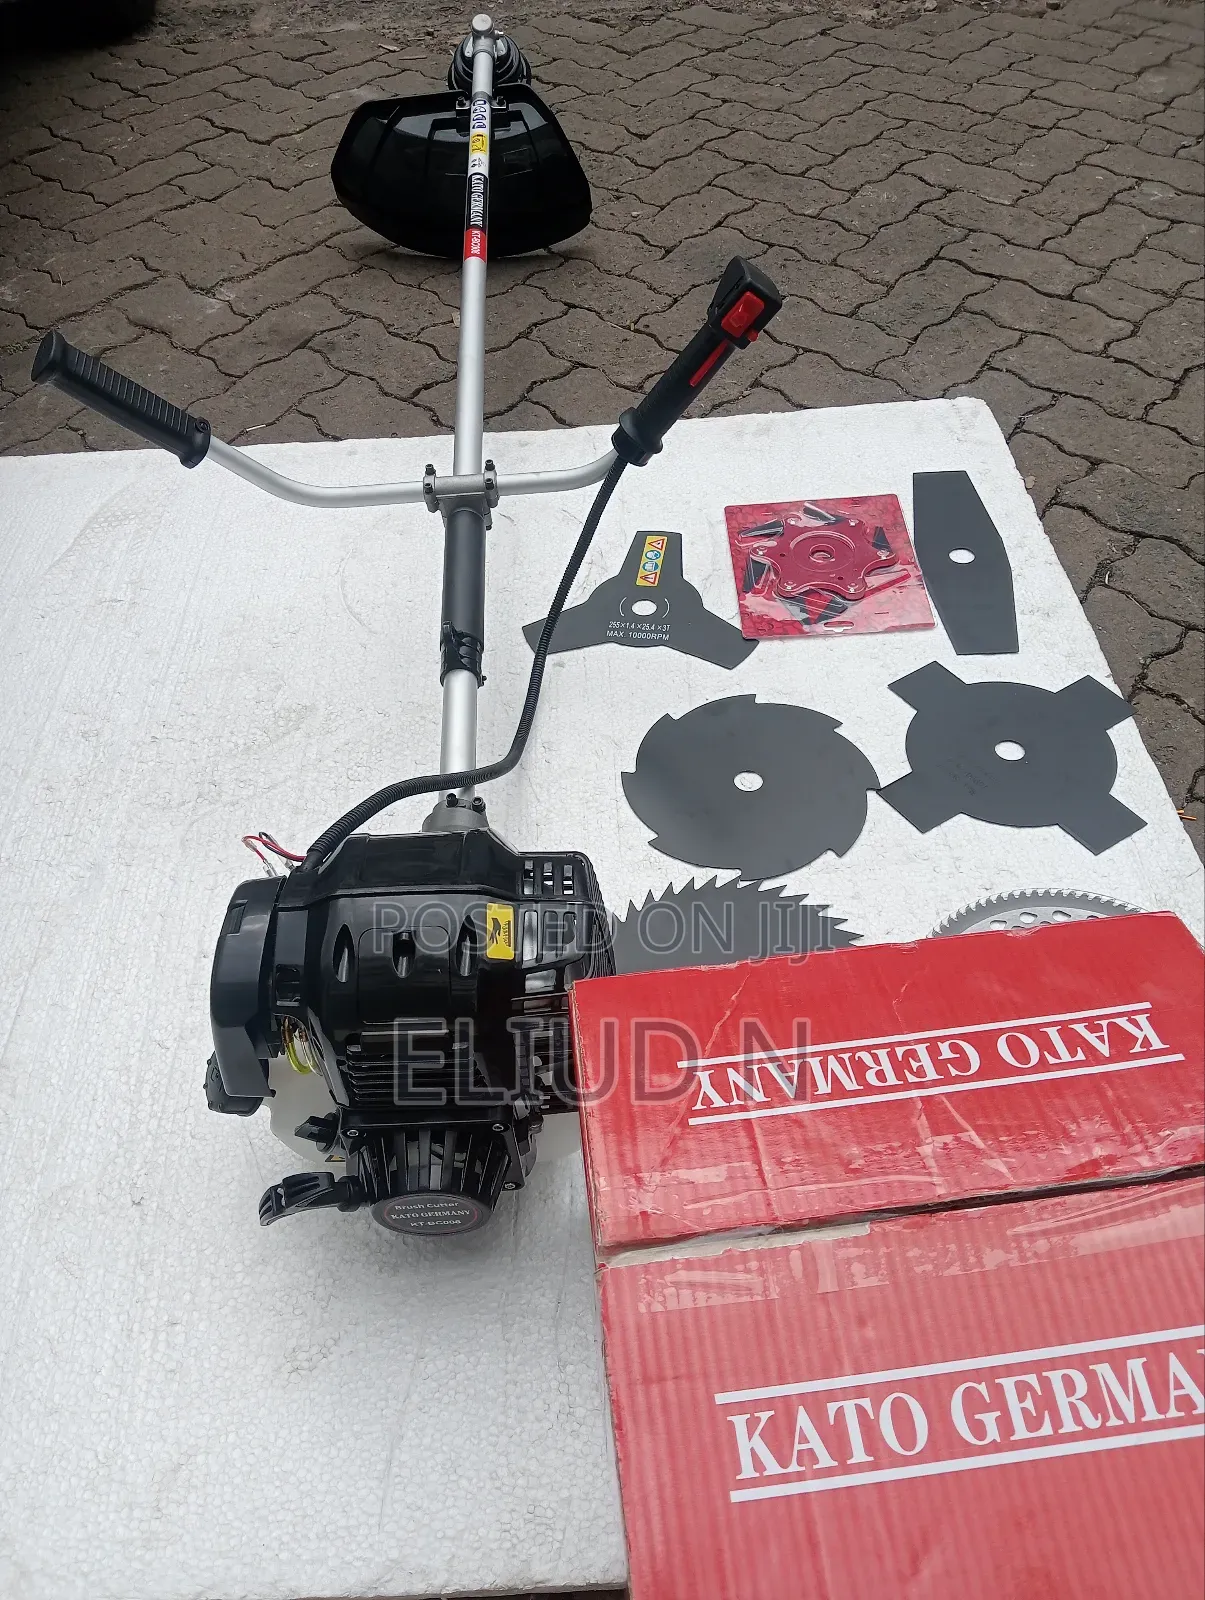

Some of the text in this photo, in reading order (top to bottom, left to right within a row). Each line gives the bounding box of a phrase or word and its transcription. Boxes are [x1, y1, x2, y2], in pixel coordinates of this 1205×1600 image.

[470, 174, 484, 227] KATO GERMANY
[628, 631, 670, 641] 10000RPM
[692, 1013, 1170, 1110] KATO GERMANY
[390, 1210, 470, 1220] KATO GERMANY
[727, 1348, 1204, 1480] KATO GERMA
